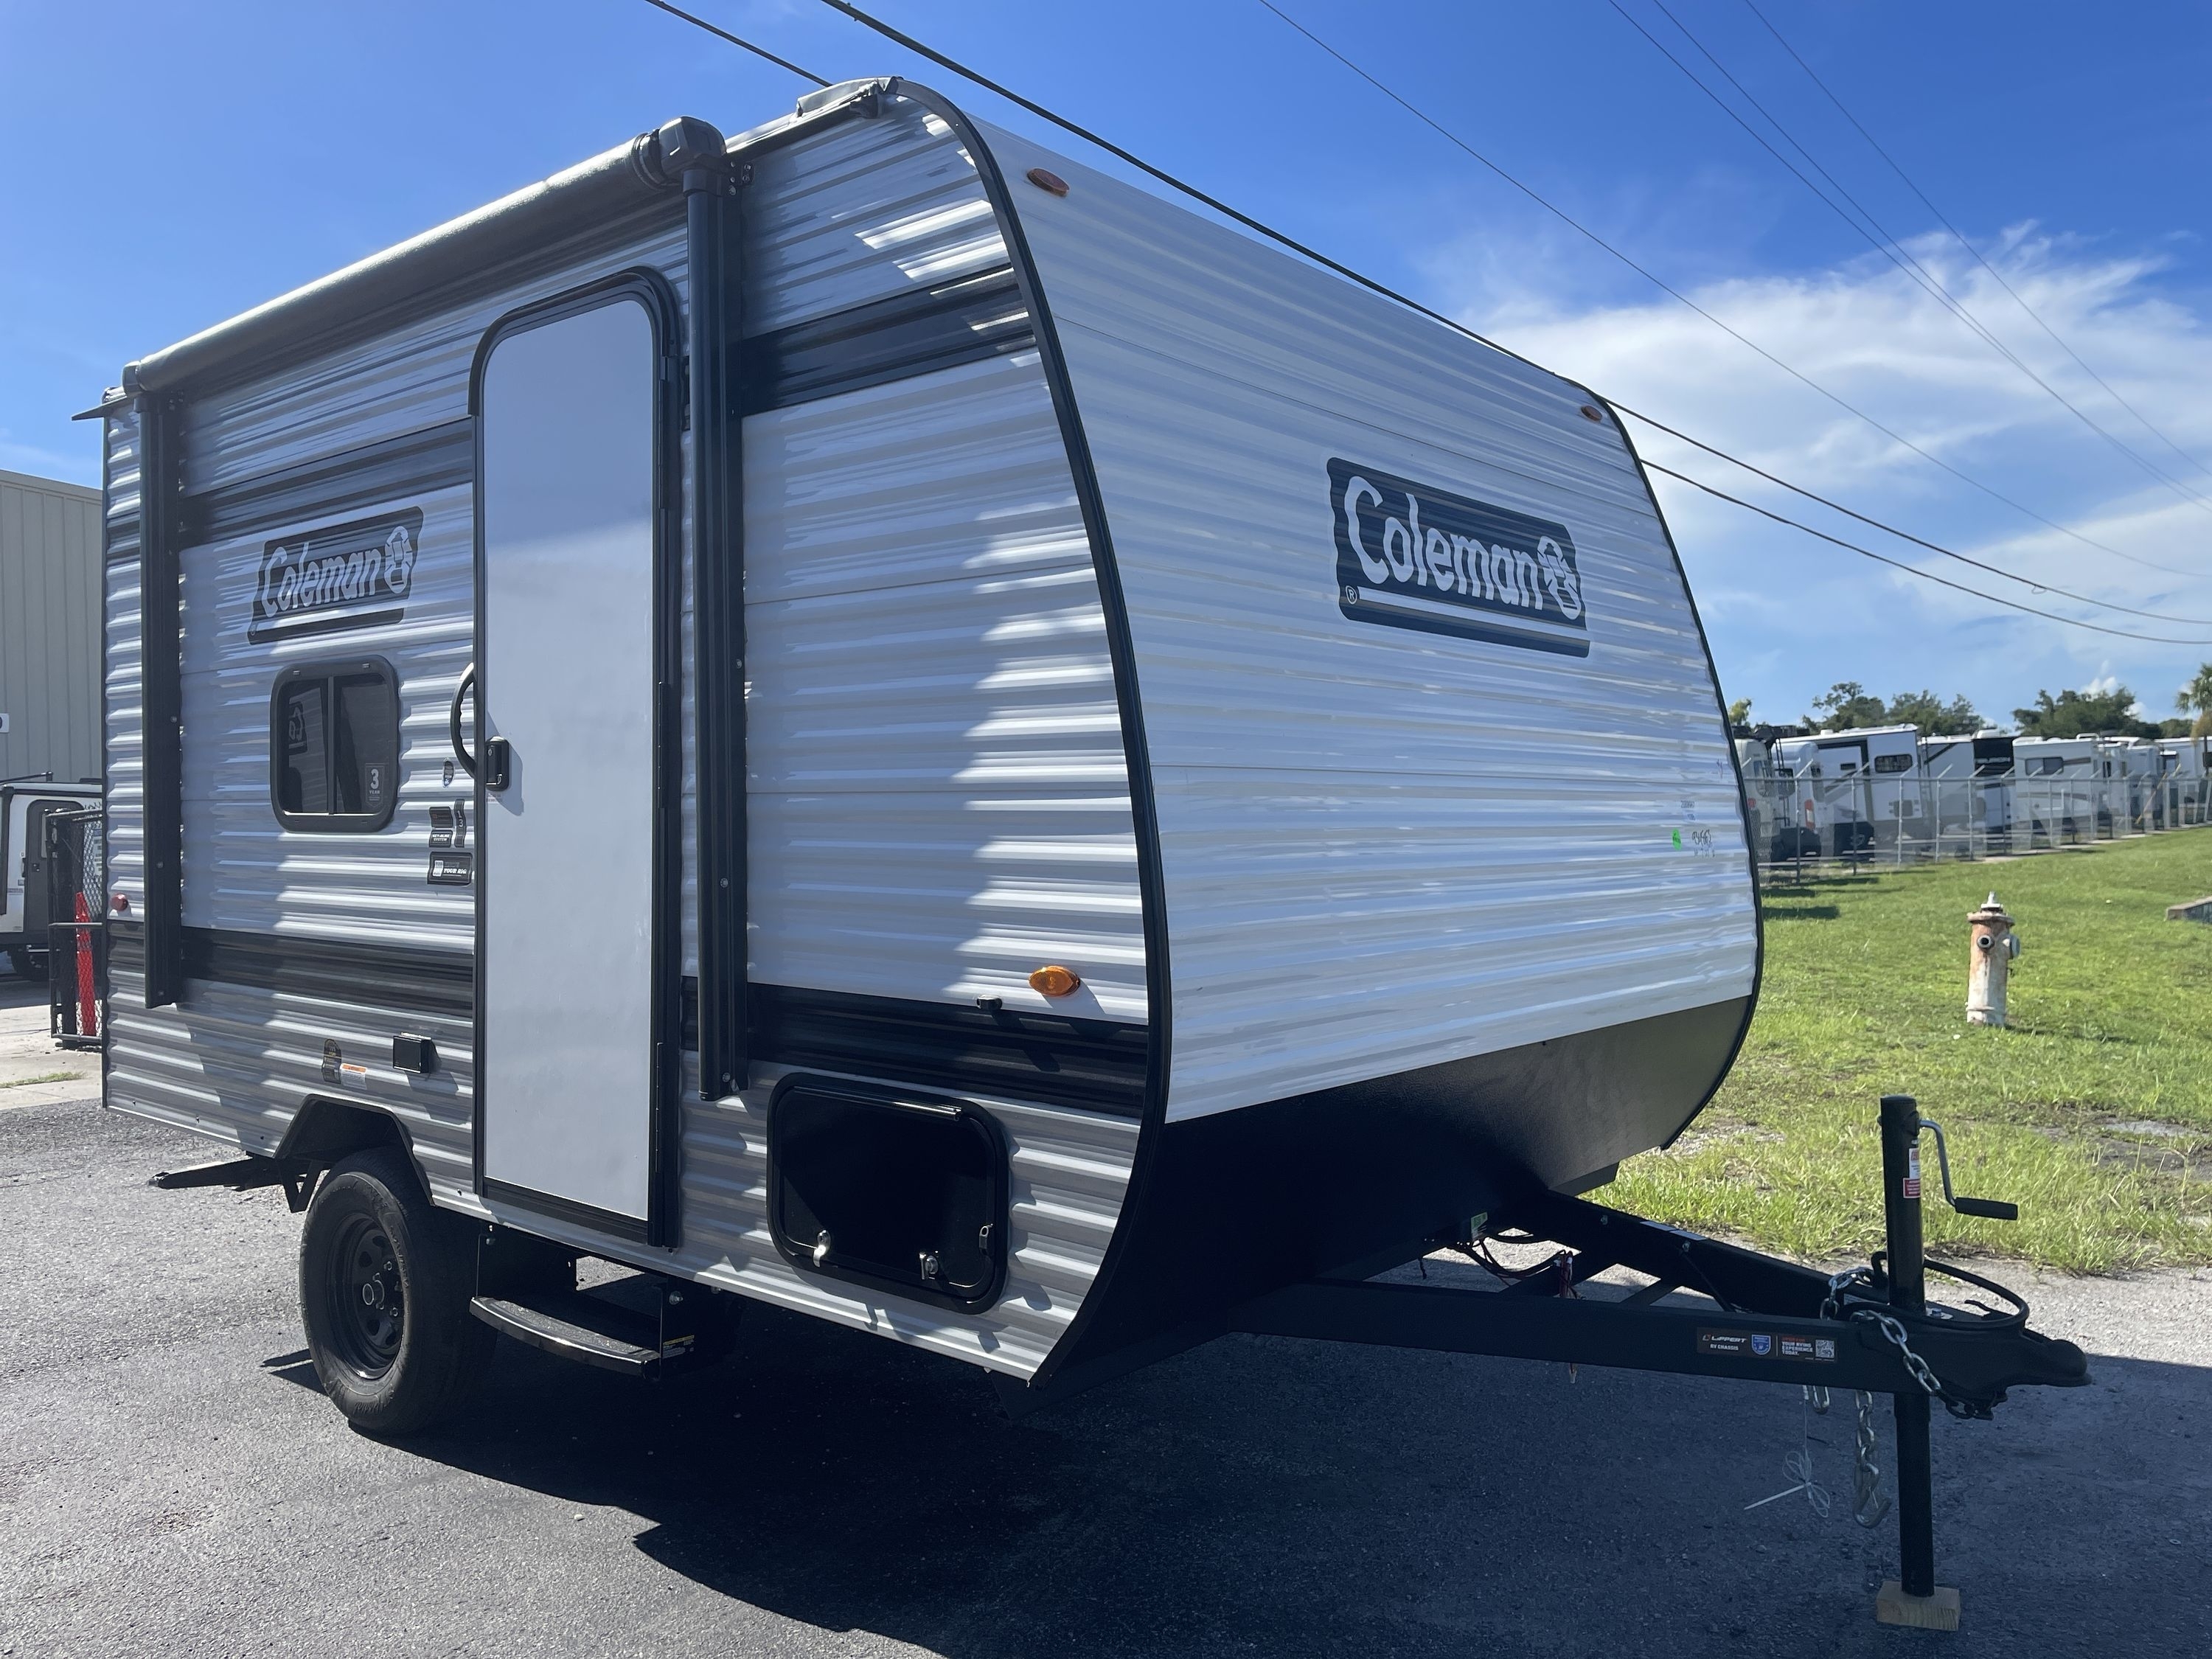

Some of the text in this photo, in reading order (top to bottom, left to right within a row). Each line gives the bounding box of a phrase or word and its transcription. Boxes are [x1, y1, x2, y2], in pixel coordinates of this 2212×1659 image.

[262, 542, 381, 618] Coleman
[1343, 476, 1543, 611] Coleman
[370, 768, 379, 790] 3
